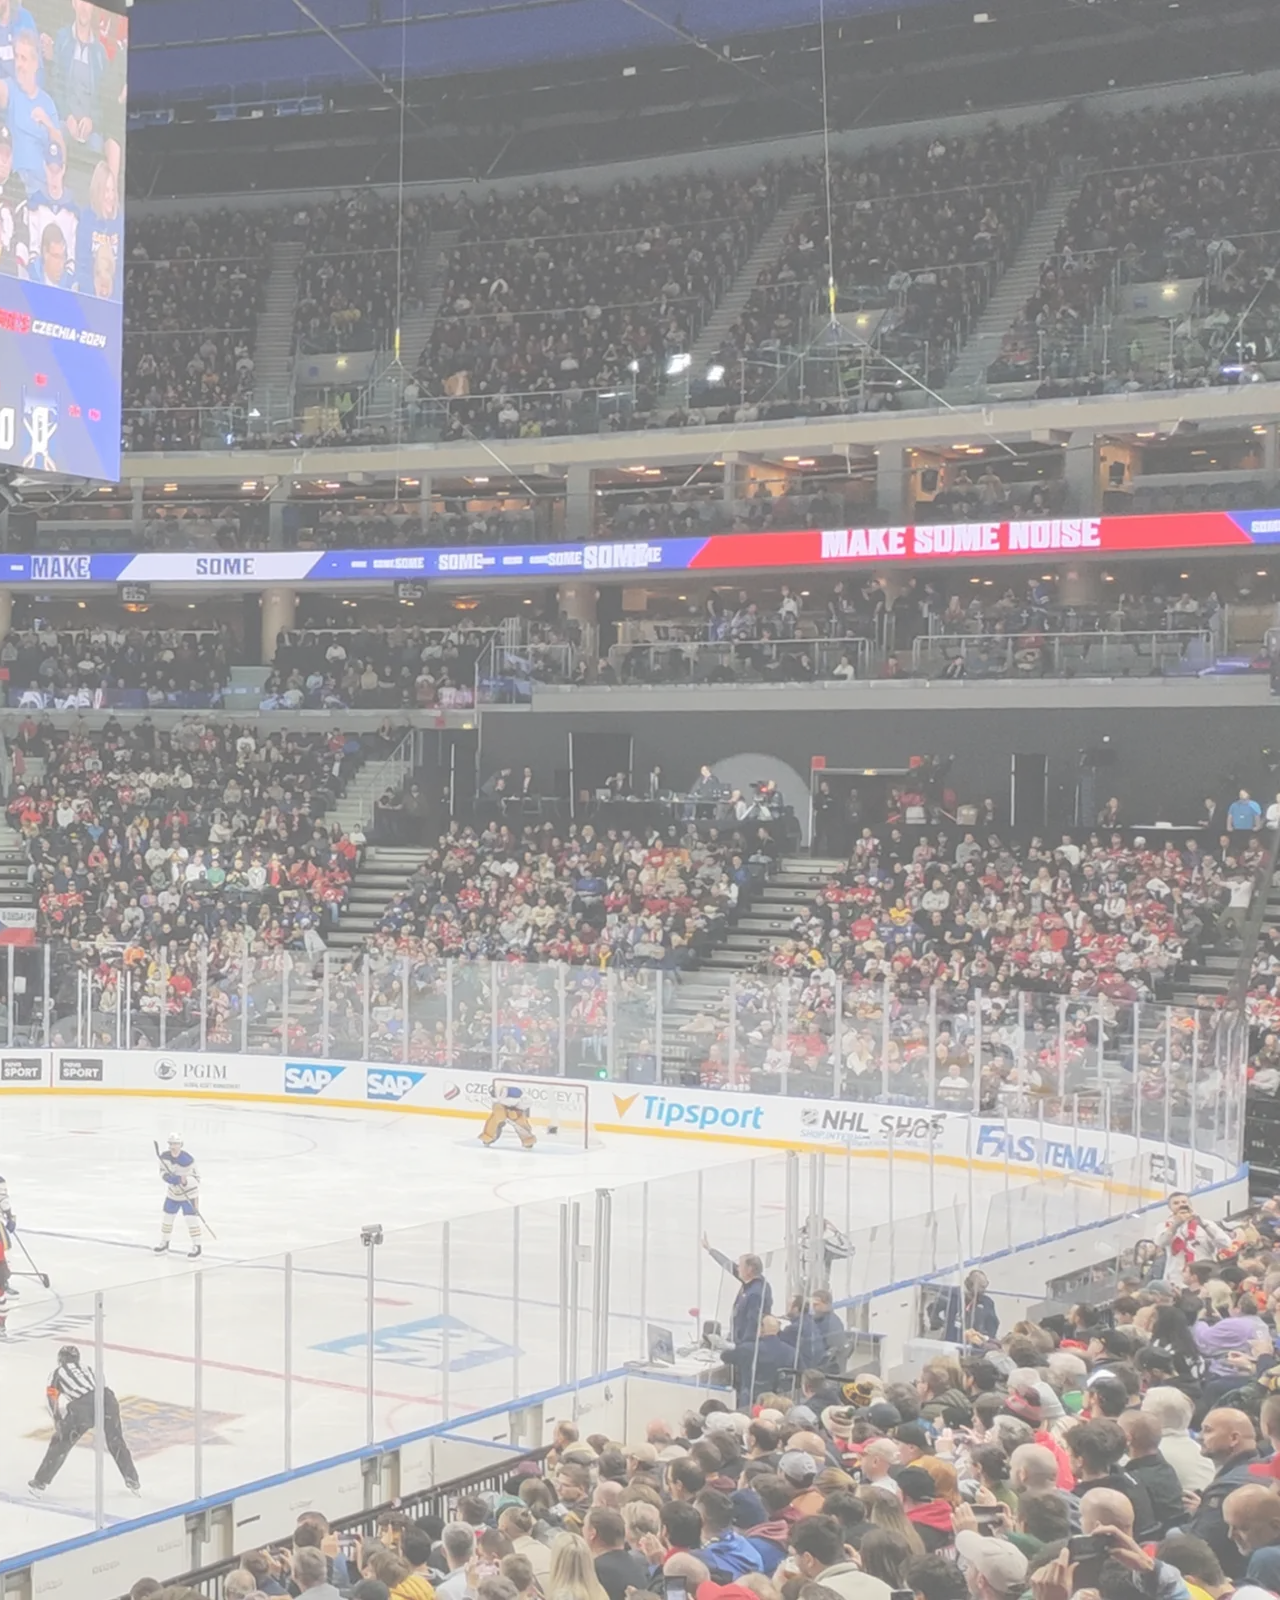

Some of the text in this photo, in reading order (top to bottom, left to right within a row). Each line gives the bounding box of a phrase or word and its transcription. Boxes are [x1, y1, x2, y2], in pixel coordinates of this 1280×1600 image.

[821, 517, 1101, 559] MAKE SOME NOISE
[31, 554, 91, 580] MAKE
[196, 558, 255, 576] SOME
[4, 1067, 39, 1077] SPORT
[63, 1067, 100, 1078] SPORT
[183, 1062, 227, 1079] PGIM
[285, 1068, 331, 1090] SAP
[368, 1073, 412, 1095] SAP
[465, 1082, 494, 1097] CZEC
[523, 1088, 572, 1102] HOCEY
[644, 1095, 765, 1129] Tipsport
[822, 1109, 869, 1133] NHL
